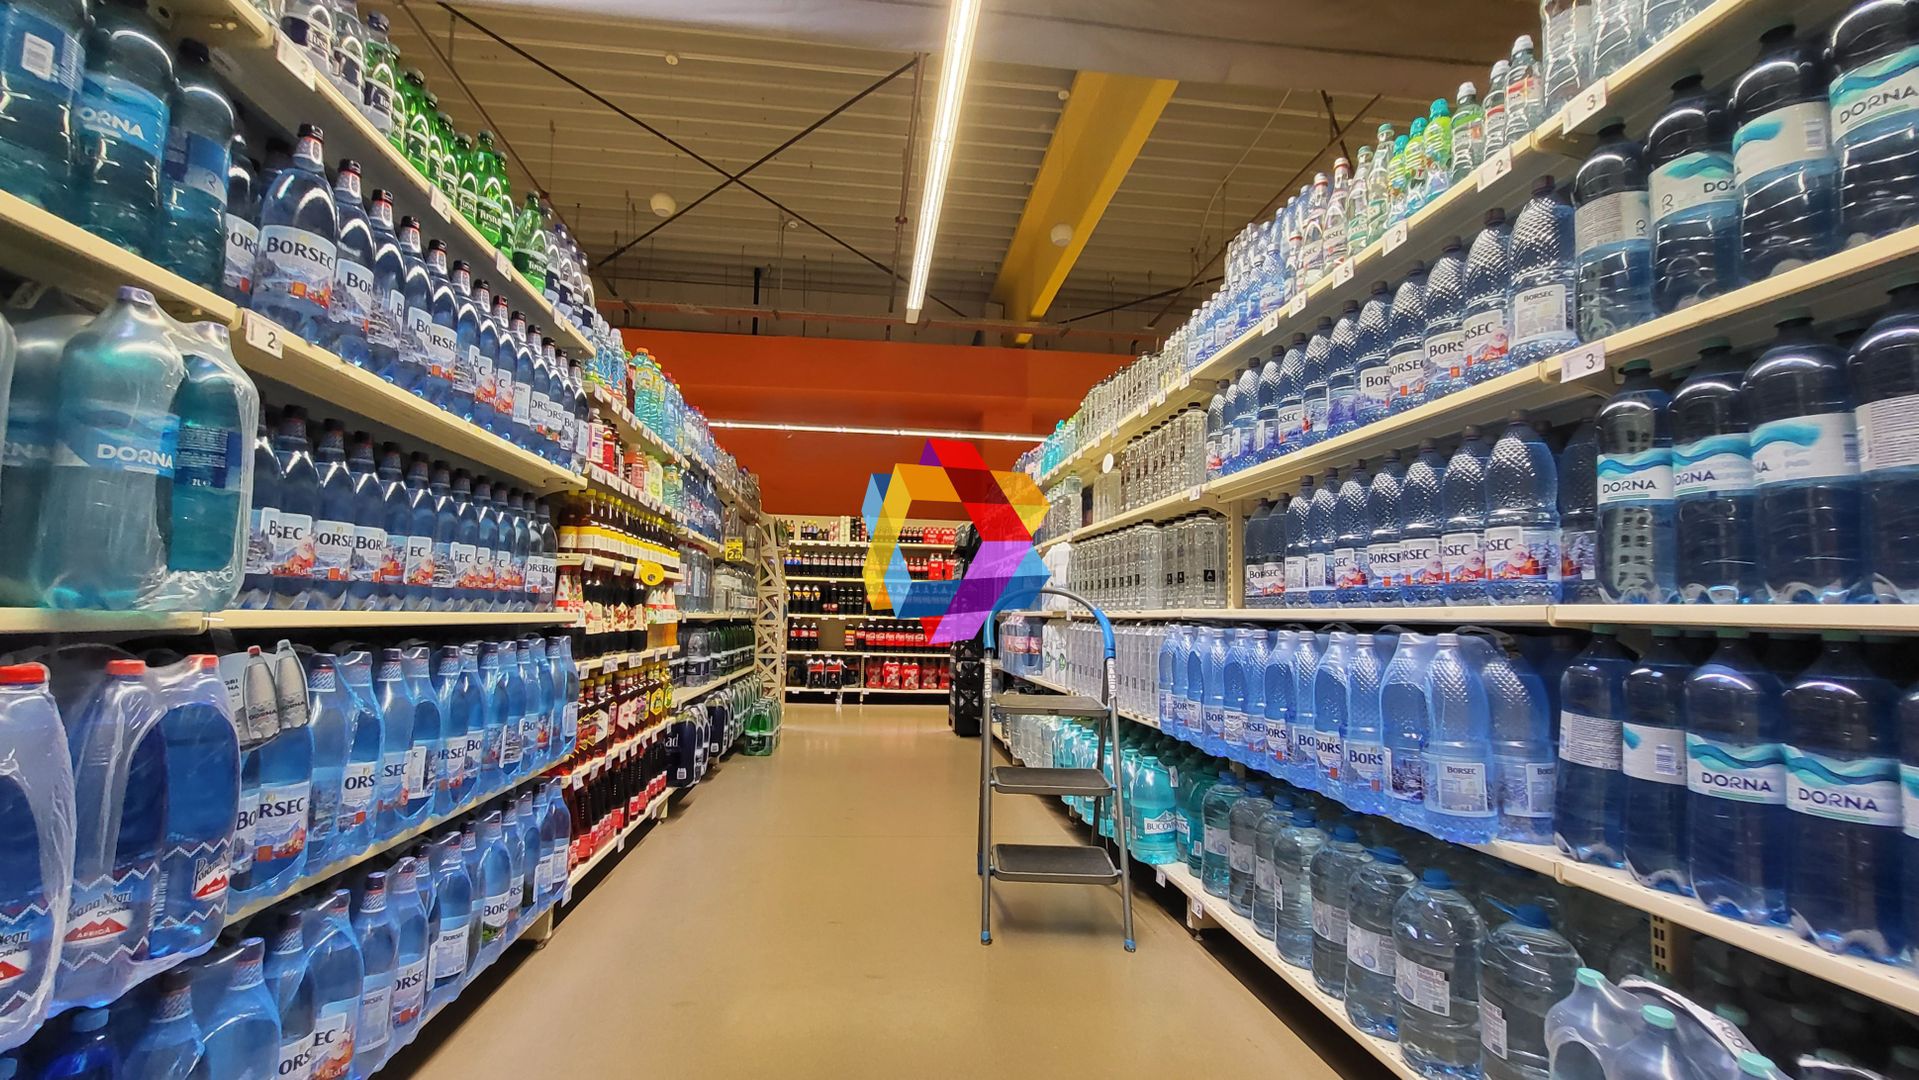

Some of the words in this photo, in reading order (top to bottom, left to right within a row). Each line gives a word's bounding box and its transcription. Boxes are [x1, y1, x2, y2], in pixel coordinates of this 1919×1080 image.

[1586, 94, 1597, 110] 3
[1839, 84, 1918, 125] DORNA
[1495, 160, 1503, 175] 2
[442, 204, 449, 217] 2
[1395, 230, 1402, 243] 2
[266, 236, 335, 271] BORSEC
[1343, 266, 1350, 278] 5
[1523, 290, 1555, 303] BORSEC
[1270, 318, 1276, 328] 2
[267, 331, 277, 350] 2
[1585, 353, 1596, 370] 3
[96, 443, 174, 469] DORNA
[1602, 479, 1657, 495] DORNA
[355, 536, 383, 552] BOR
[1349, 750, 1384, 766] BORS
[1446, 766, 1476, 775] BORSEC
[1701, 771, 1773, 793] DORNA
[1798, 787, 1879, 813] DORNA
[1196, 904, 1202, 915] 2
[442, 931, 465, 942] BORSEC
